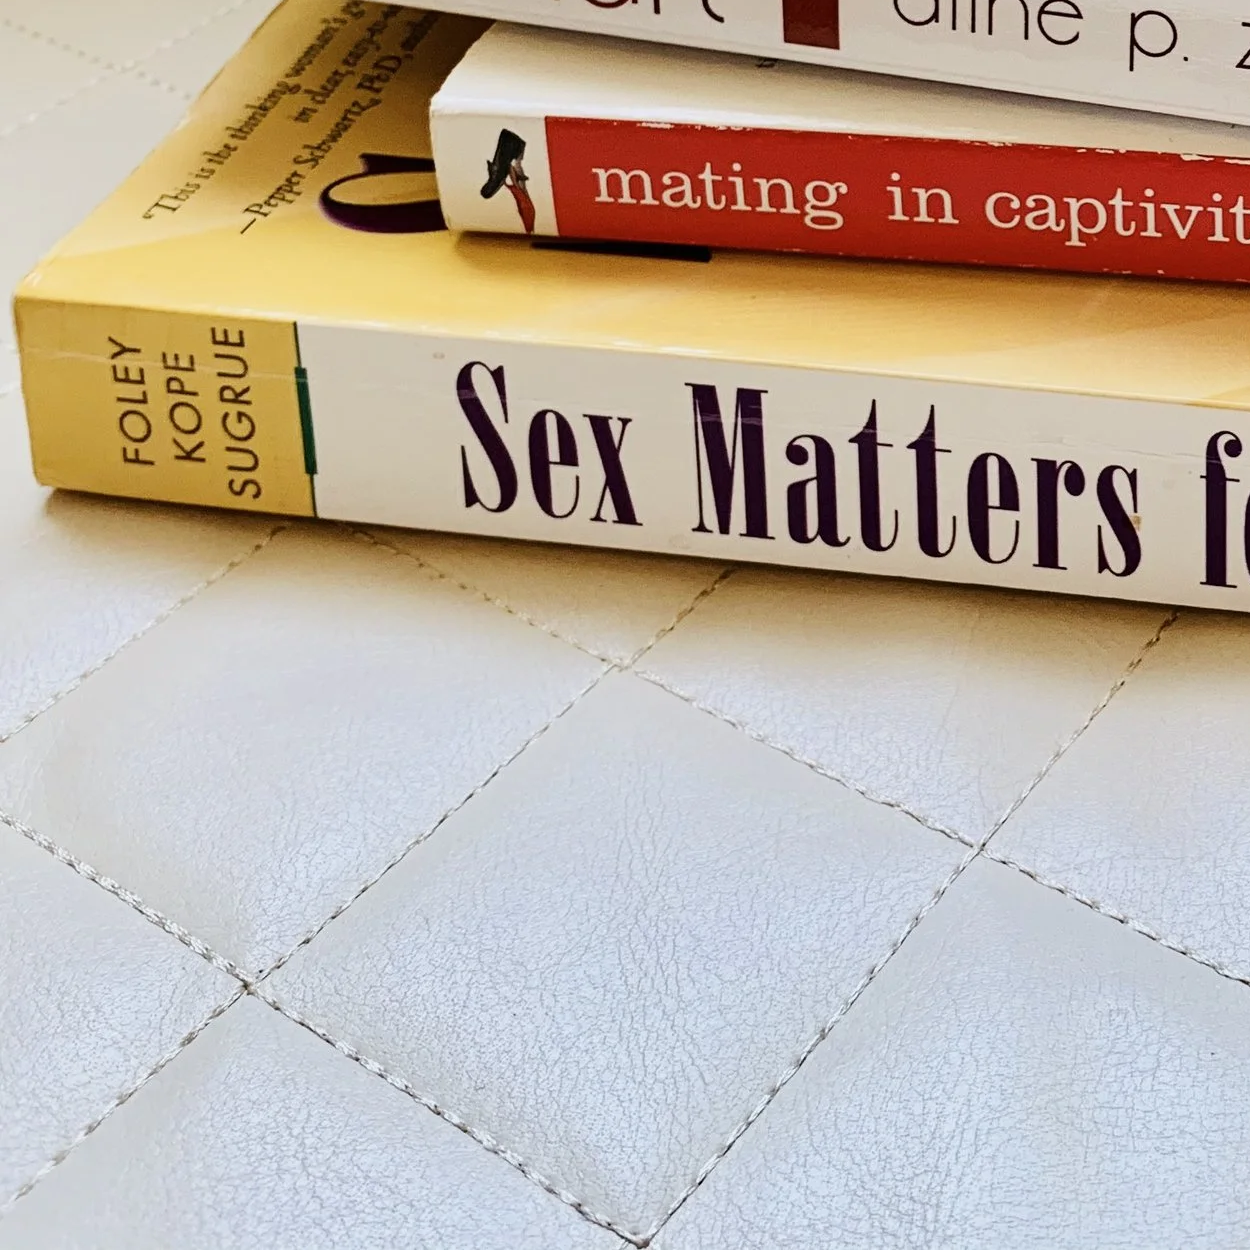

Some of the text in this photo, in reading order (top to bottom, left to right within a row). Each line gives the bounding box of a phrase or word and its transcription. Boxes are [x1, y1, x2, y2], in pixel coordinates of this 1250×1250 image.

[1128, 10, 1189, 72] p.
[224, 79, 302, 141] thinking
[195, 171, 216, 191] is
[203, 142, 238, 174] the
[592, 163, 848, 231] mating
[887, 173, 959, 224] in
[107, 336, 156, 468] FOLEY
[161, 351, 208, 464] KOPE
[210, 326, 262, 500] SUGRUE
[455, 360, 643, 527] Sex
[684, 382, 1143, 578] Matters
